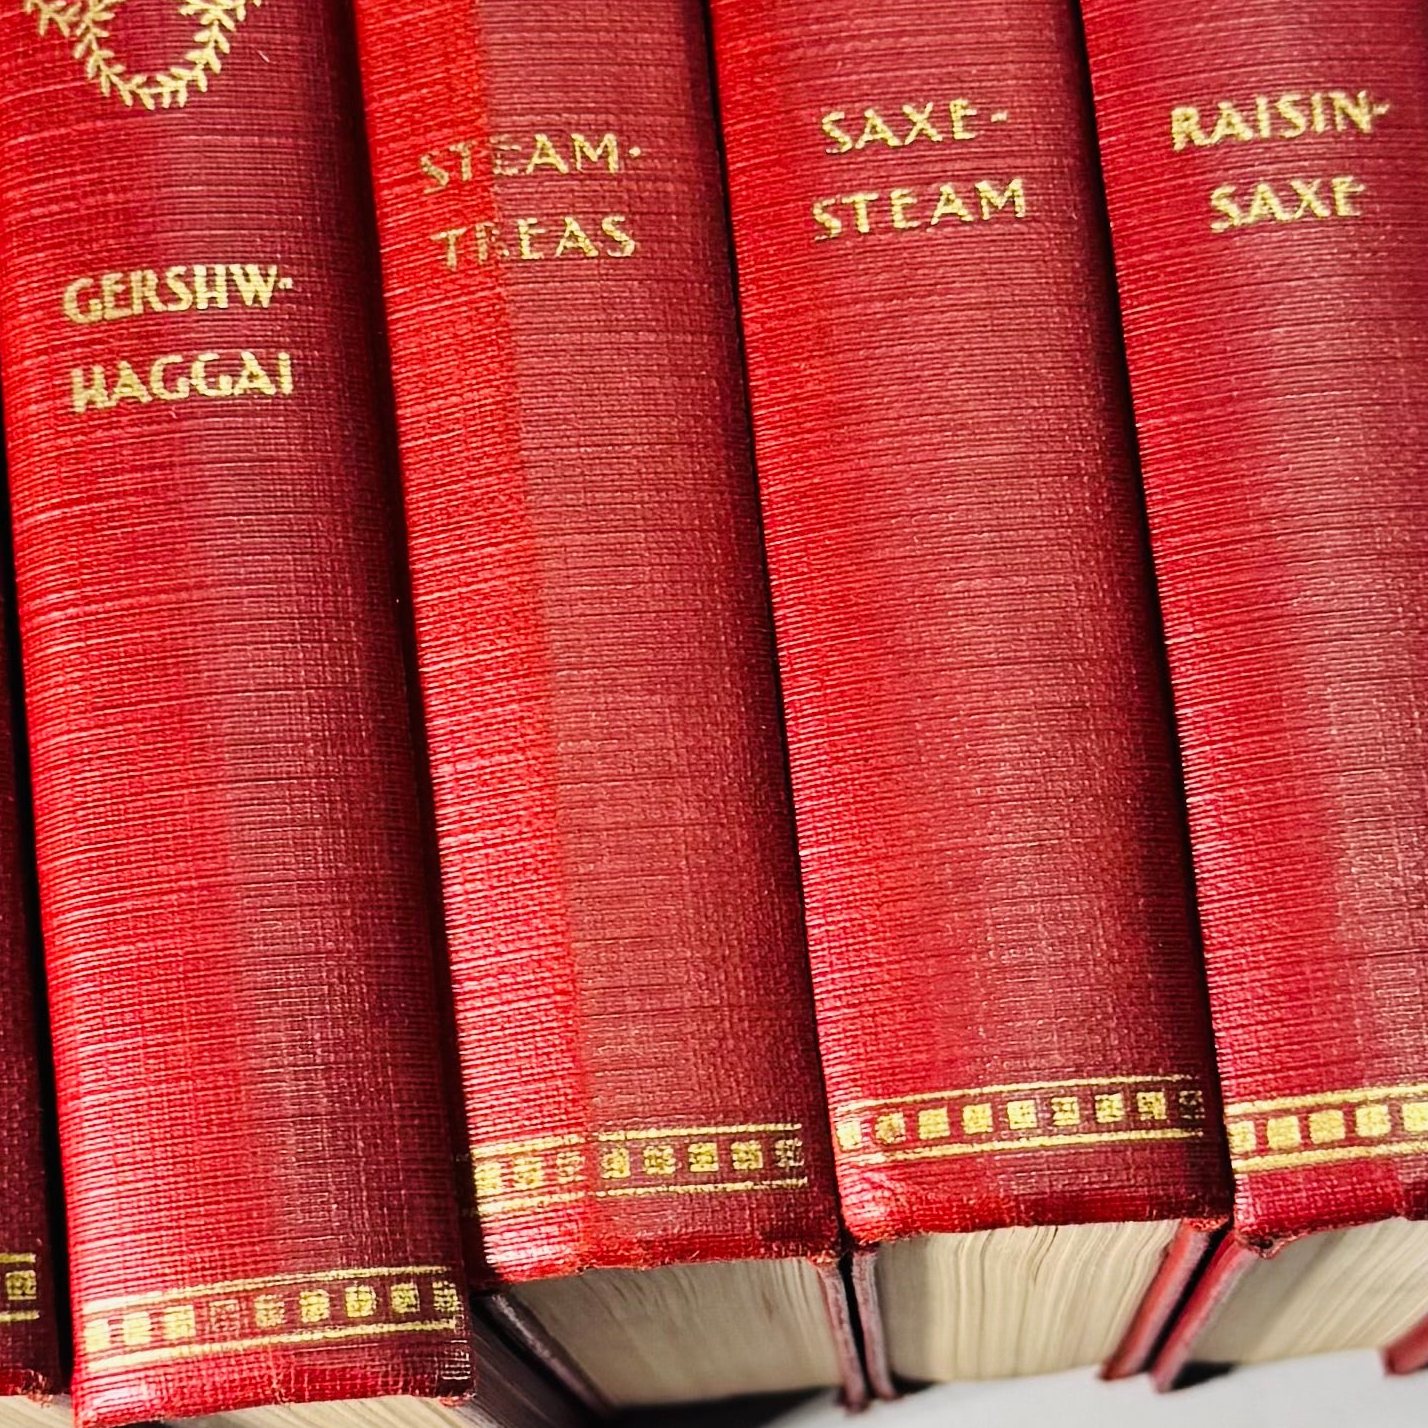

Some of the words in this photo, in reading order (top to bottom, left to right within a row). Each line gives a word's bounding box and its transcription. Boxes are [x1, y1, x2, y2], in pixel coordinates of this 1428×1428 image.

[821, 97, 1009, 154] SAXE-
[1171, 90, 1391, 151] RAISIN-
[812, 178, 1026, 241] STEAM
[1210, 176, 1366, 233] SAXE
[430, 216, 636, 272] TREAS
[63, 263, 293, 324] GERSHW-
[72, 351, 294, 413] HAGGAI
